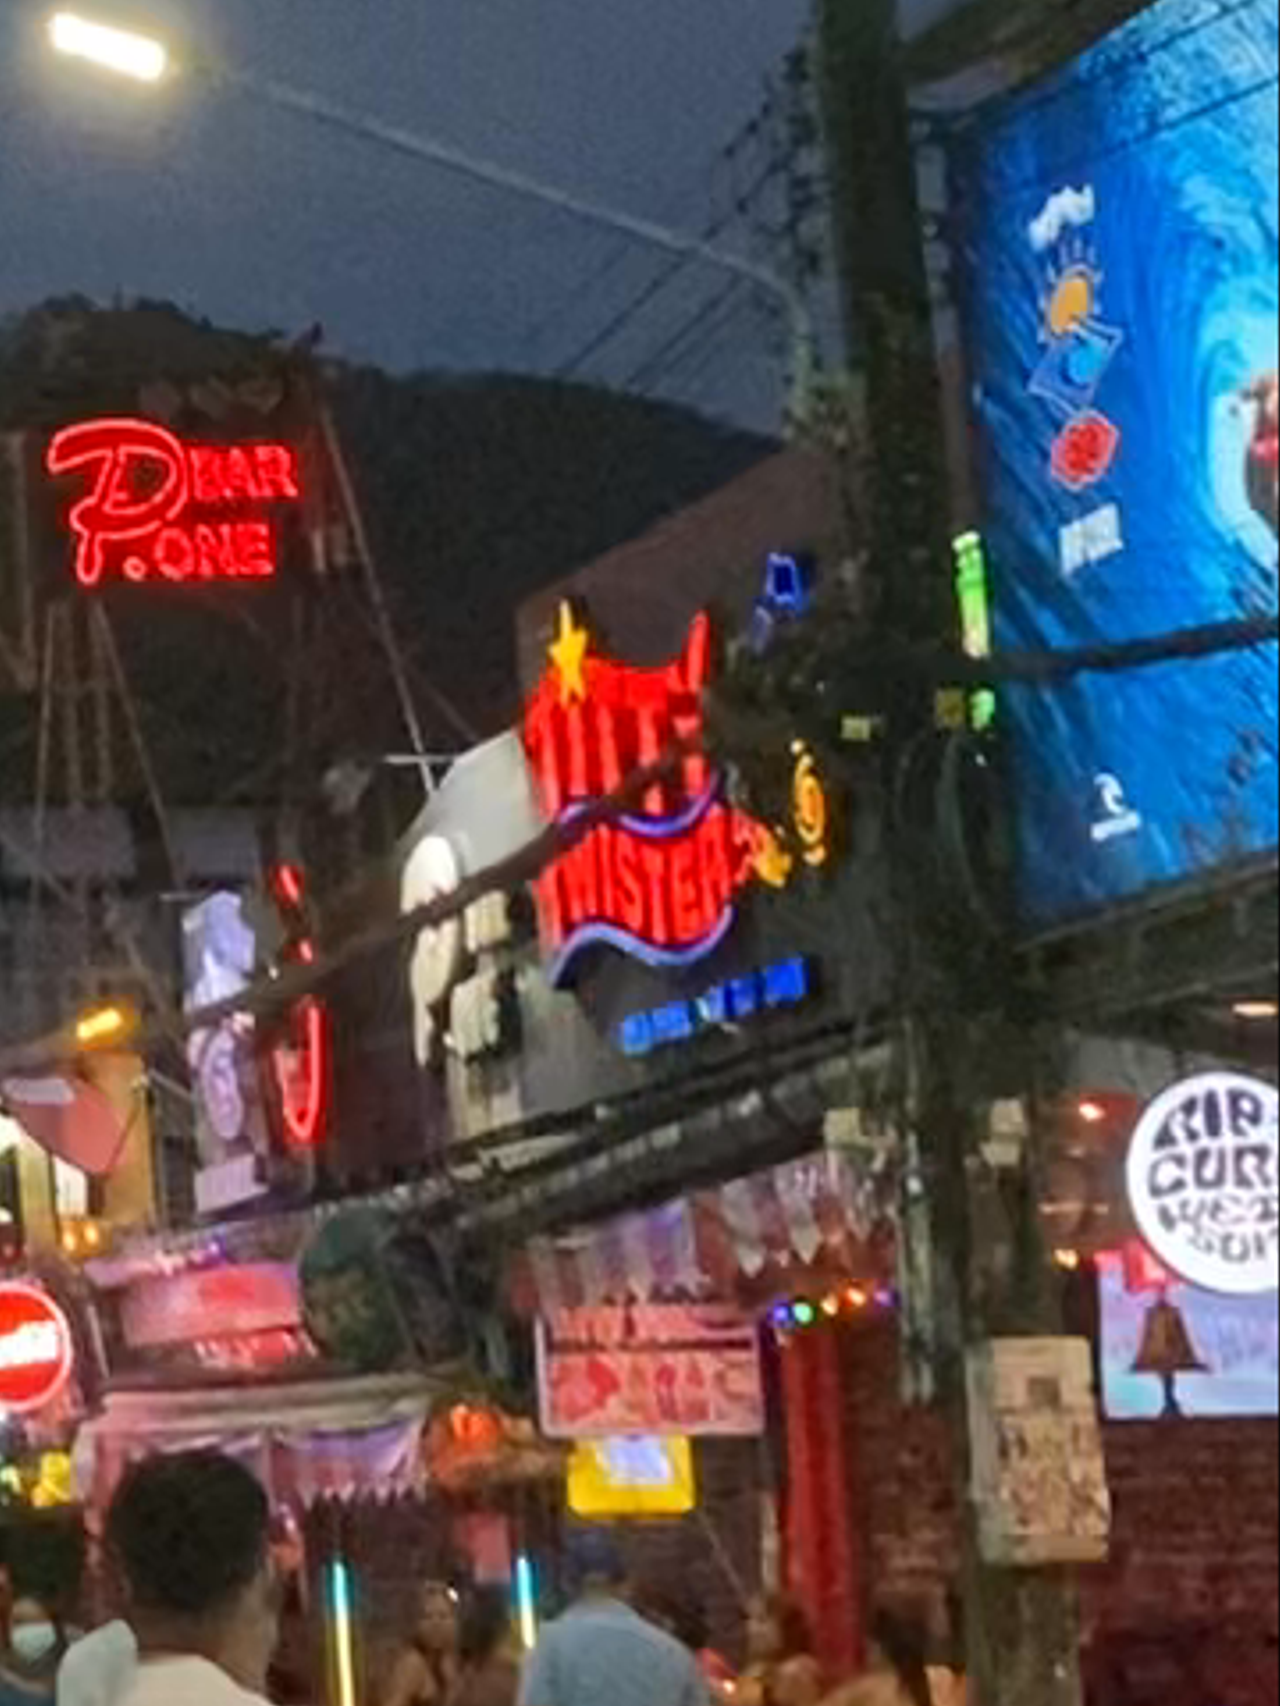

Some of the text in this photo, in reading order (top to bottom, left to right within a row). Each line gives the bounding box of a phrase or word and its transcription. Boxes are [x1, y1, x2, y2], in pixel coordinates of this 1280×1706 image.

[190, 444, 298, 500] BAR
[1153, 1088, 1264, 1151] RIP
[1148, 1142, 1278, 1199] CUR
